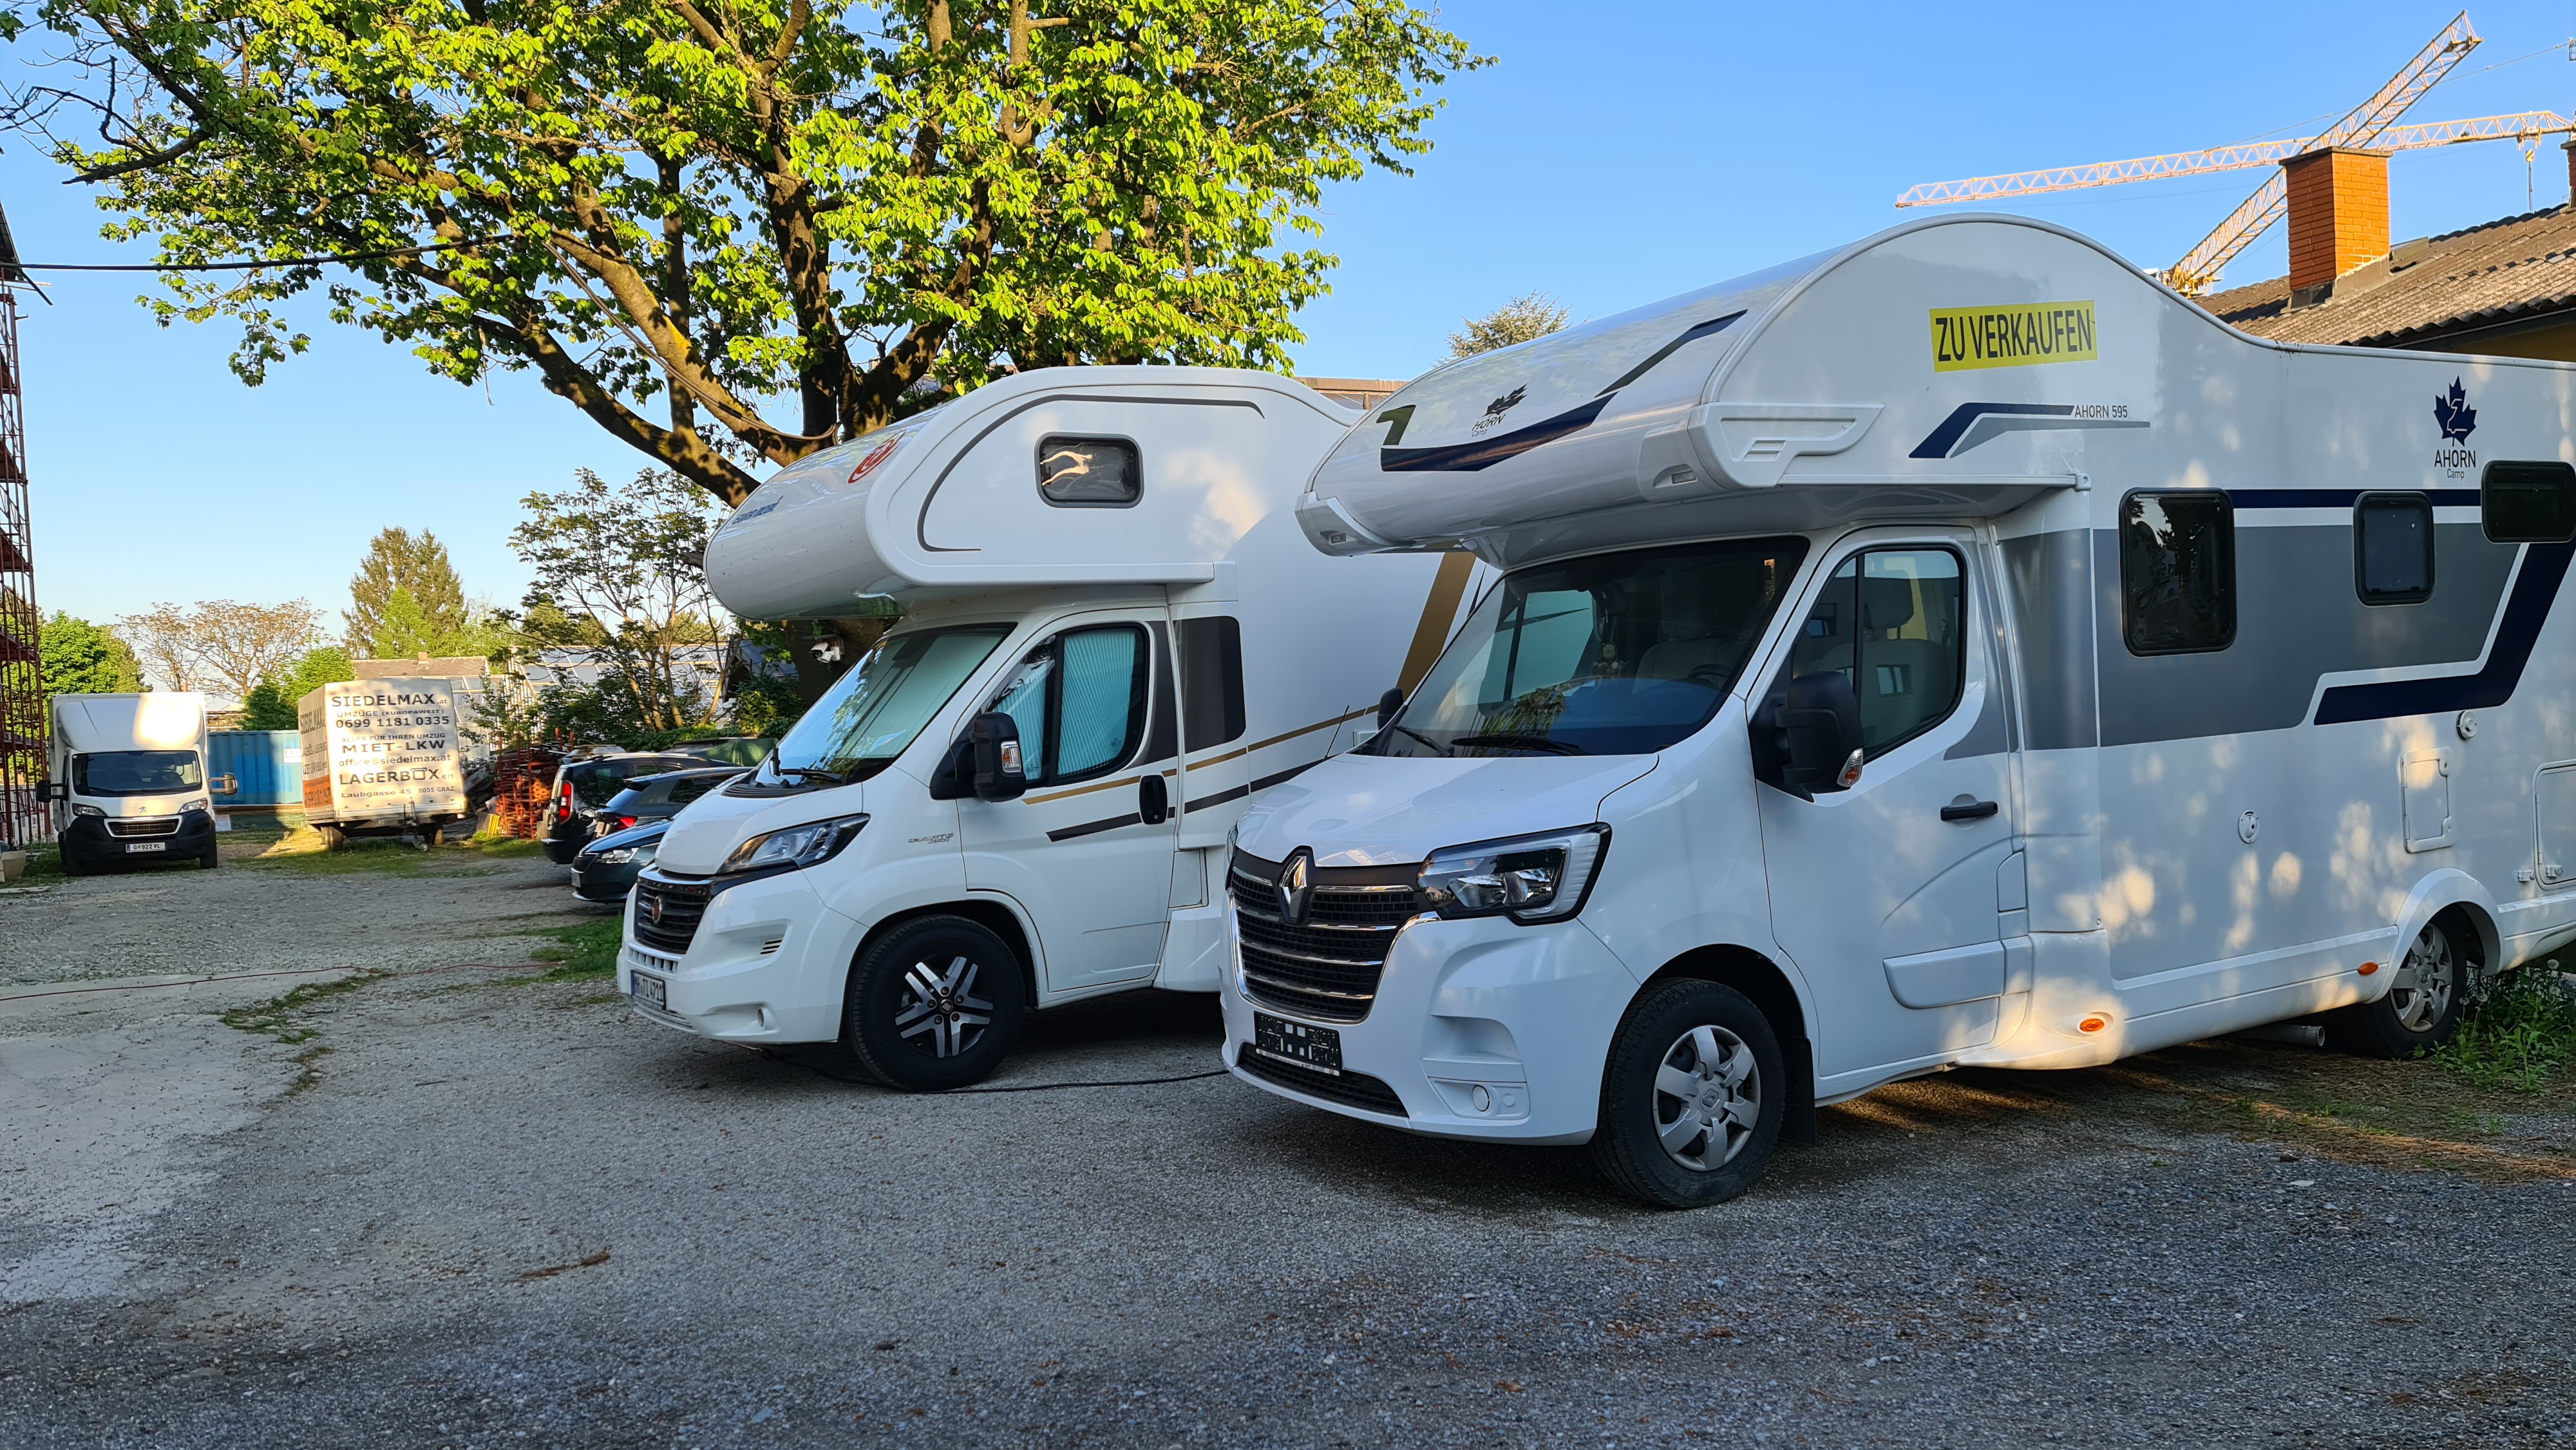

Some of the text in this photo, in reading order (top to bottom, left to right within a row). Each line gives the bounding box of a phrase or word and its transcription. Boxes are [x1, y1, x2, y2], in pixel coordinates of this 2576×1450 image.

[1935, 308, 2092, 362] ZU VERKAUFEN
[2074, 404, 2128, 418] AHORN 595
[2434, 449, 2476, 468] AHORN
[2447, 468, 2465, 481] Camp
[337, 710, 379, 718] UMZÜGE
[336, 716, 450, 728] 0699 1181 0335
[342, 740, 446, 754] MIET-LKW
[338, 753, 452, 766] office@siedelmax.at
[341, 790, 396, 798] Laubgasse
[650, 981, 663, 1002] 4711
